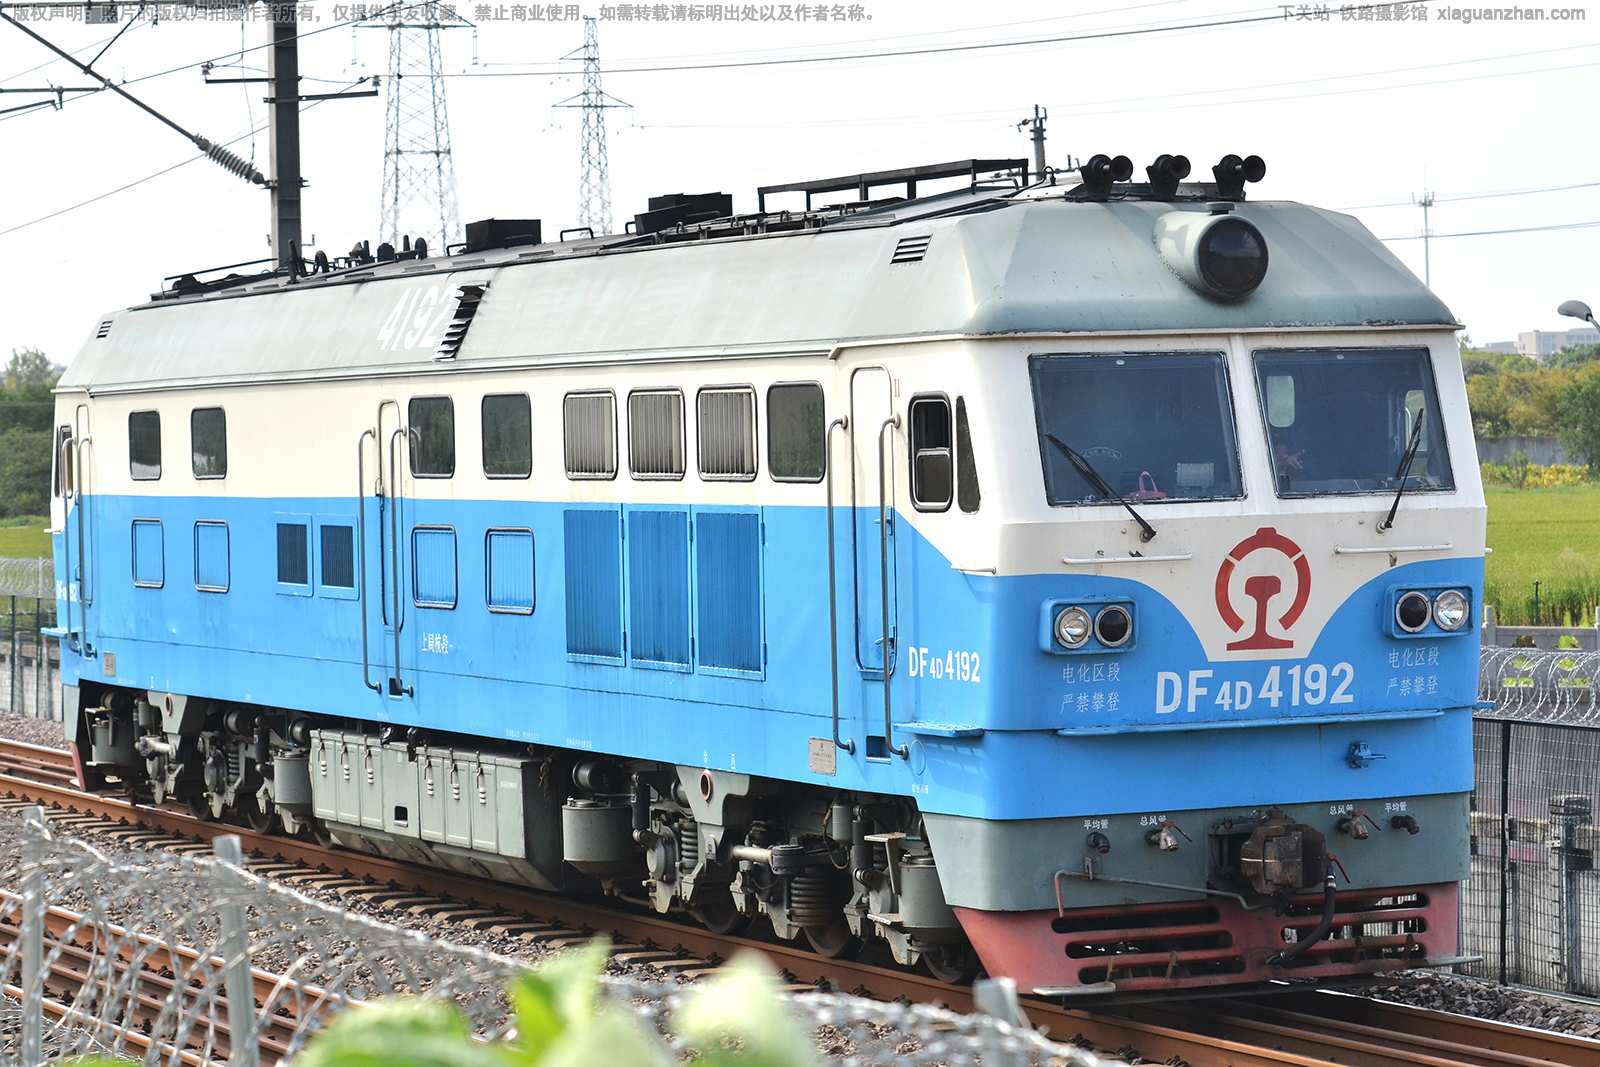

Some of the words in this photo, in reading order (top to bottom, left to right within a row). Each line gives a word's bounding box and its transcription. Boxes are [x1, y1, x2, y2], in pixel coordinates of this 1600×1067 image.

[376, 283, 464, 351] 4192
[1389, 646, 1440, 669] 电化区段
[1062, 662, 1121, 684] 电化区段
[1386, 675, 1438, 698] 严禁攀登
[1060, 691, 1120, 714] 严禁攀登
[1384, 801, 1407, 812] 平均管
[1083, 819, 1109, 830] 平均管
